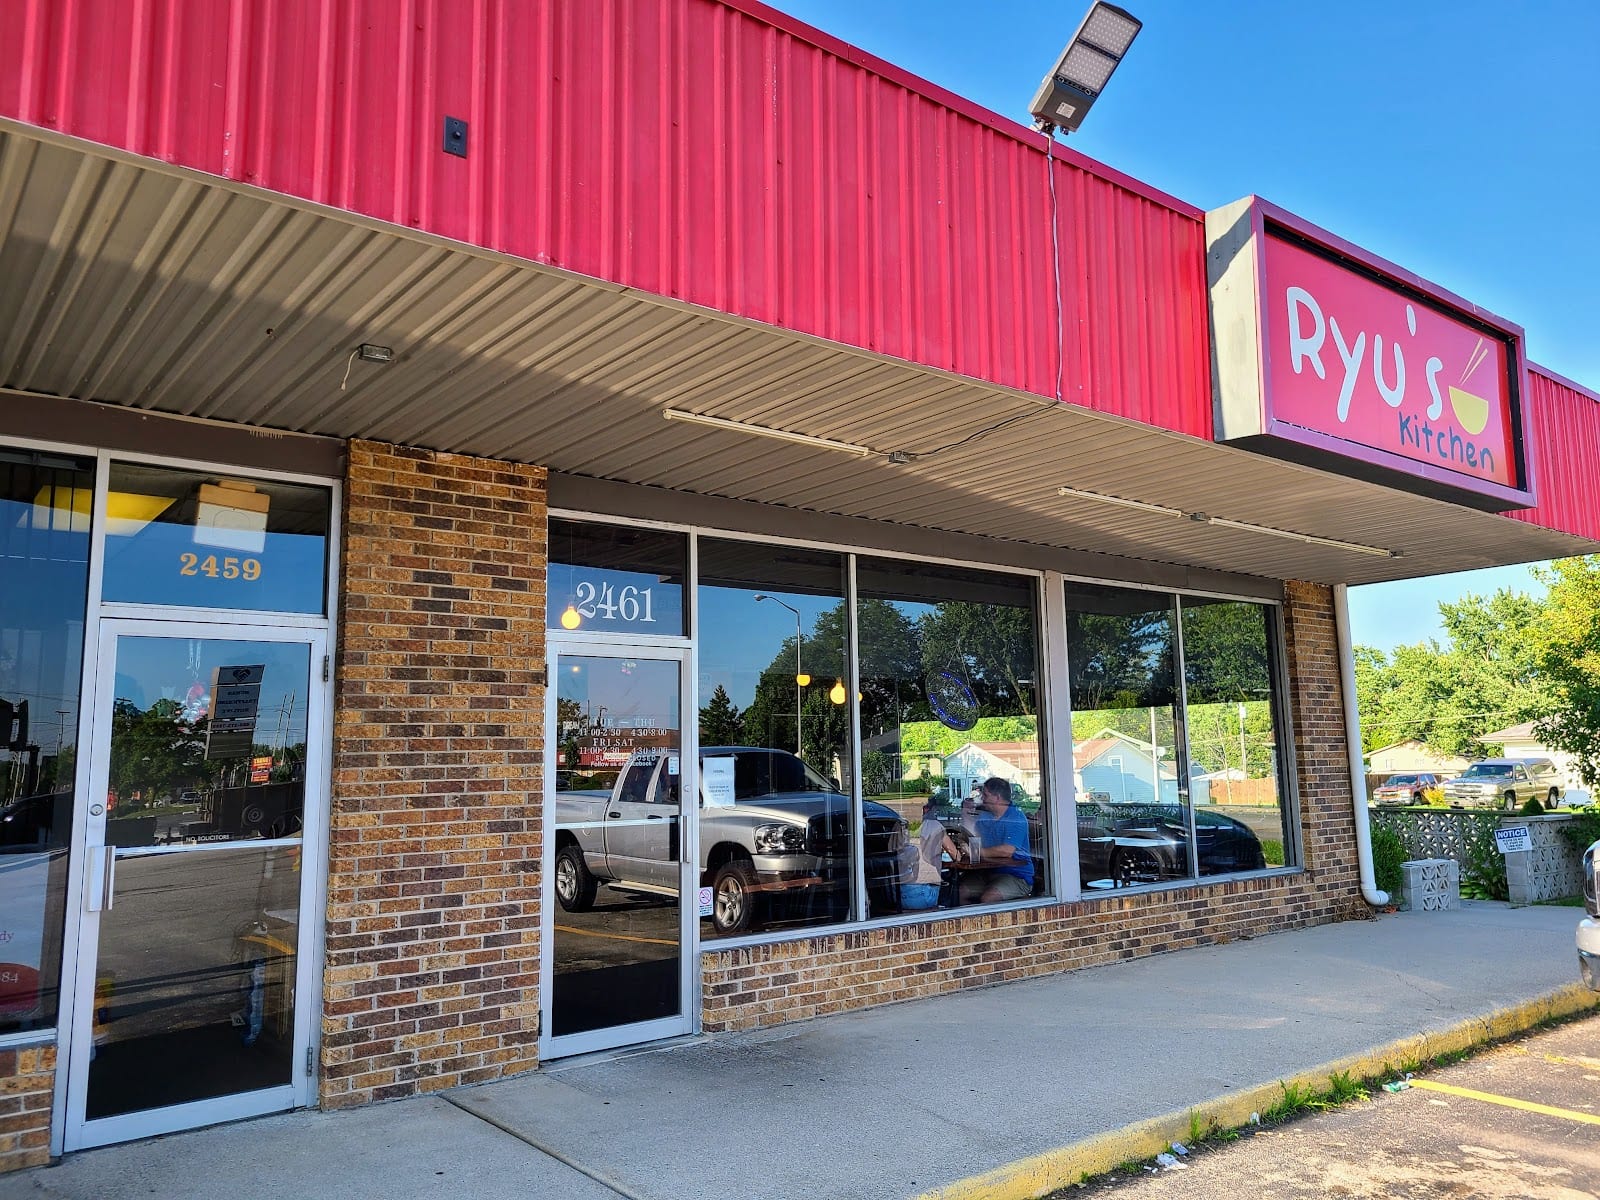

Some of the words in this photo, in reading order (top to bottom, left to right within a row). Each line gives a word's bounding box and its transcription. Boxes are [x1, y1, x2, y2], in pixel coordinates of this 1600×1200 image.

[1287, 286, 1443, 423] Ryu's
[1399, 411, 1495, 473] Kitchen
[180, 553, 261, 580] 2459
[576, 581, 657, 621] 2461
[633, 718, 655, 727] THU
[1497, 829, 1526, 838] NOTICE
